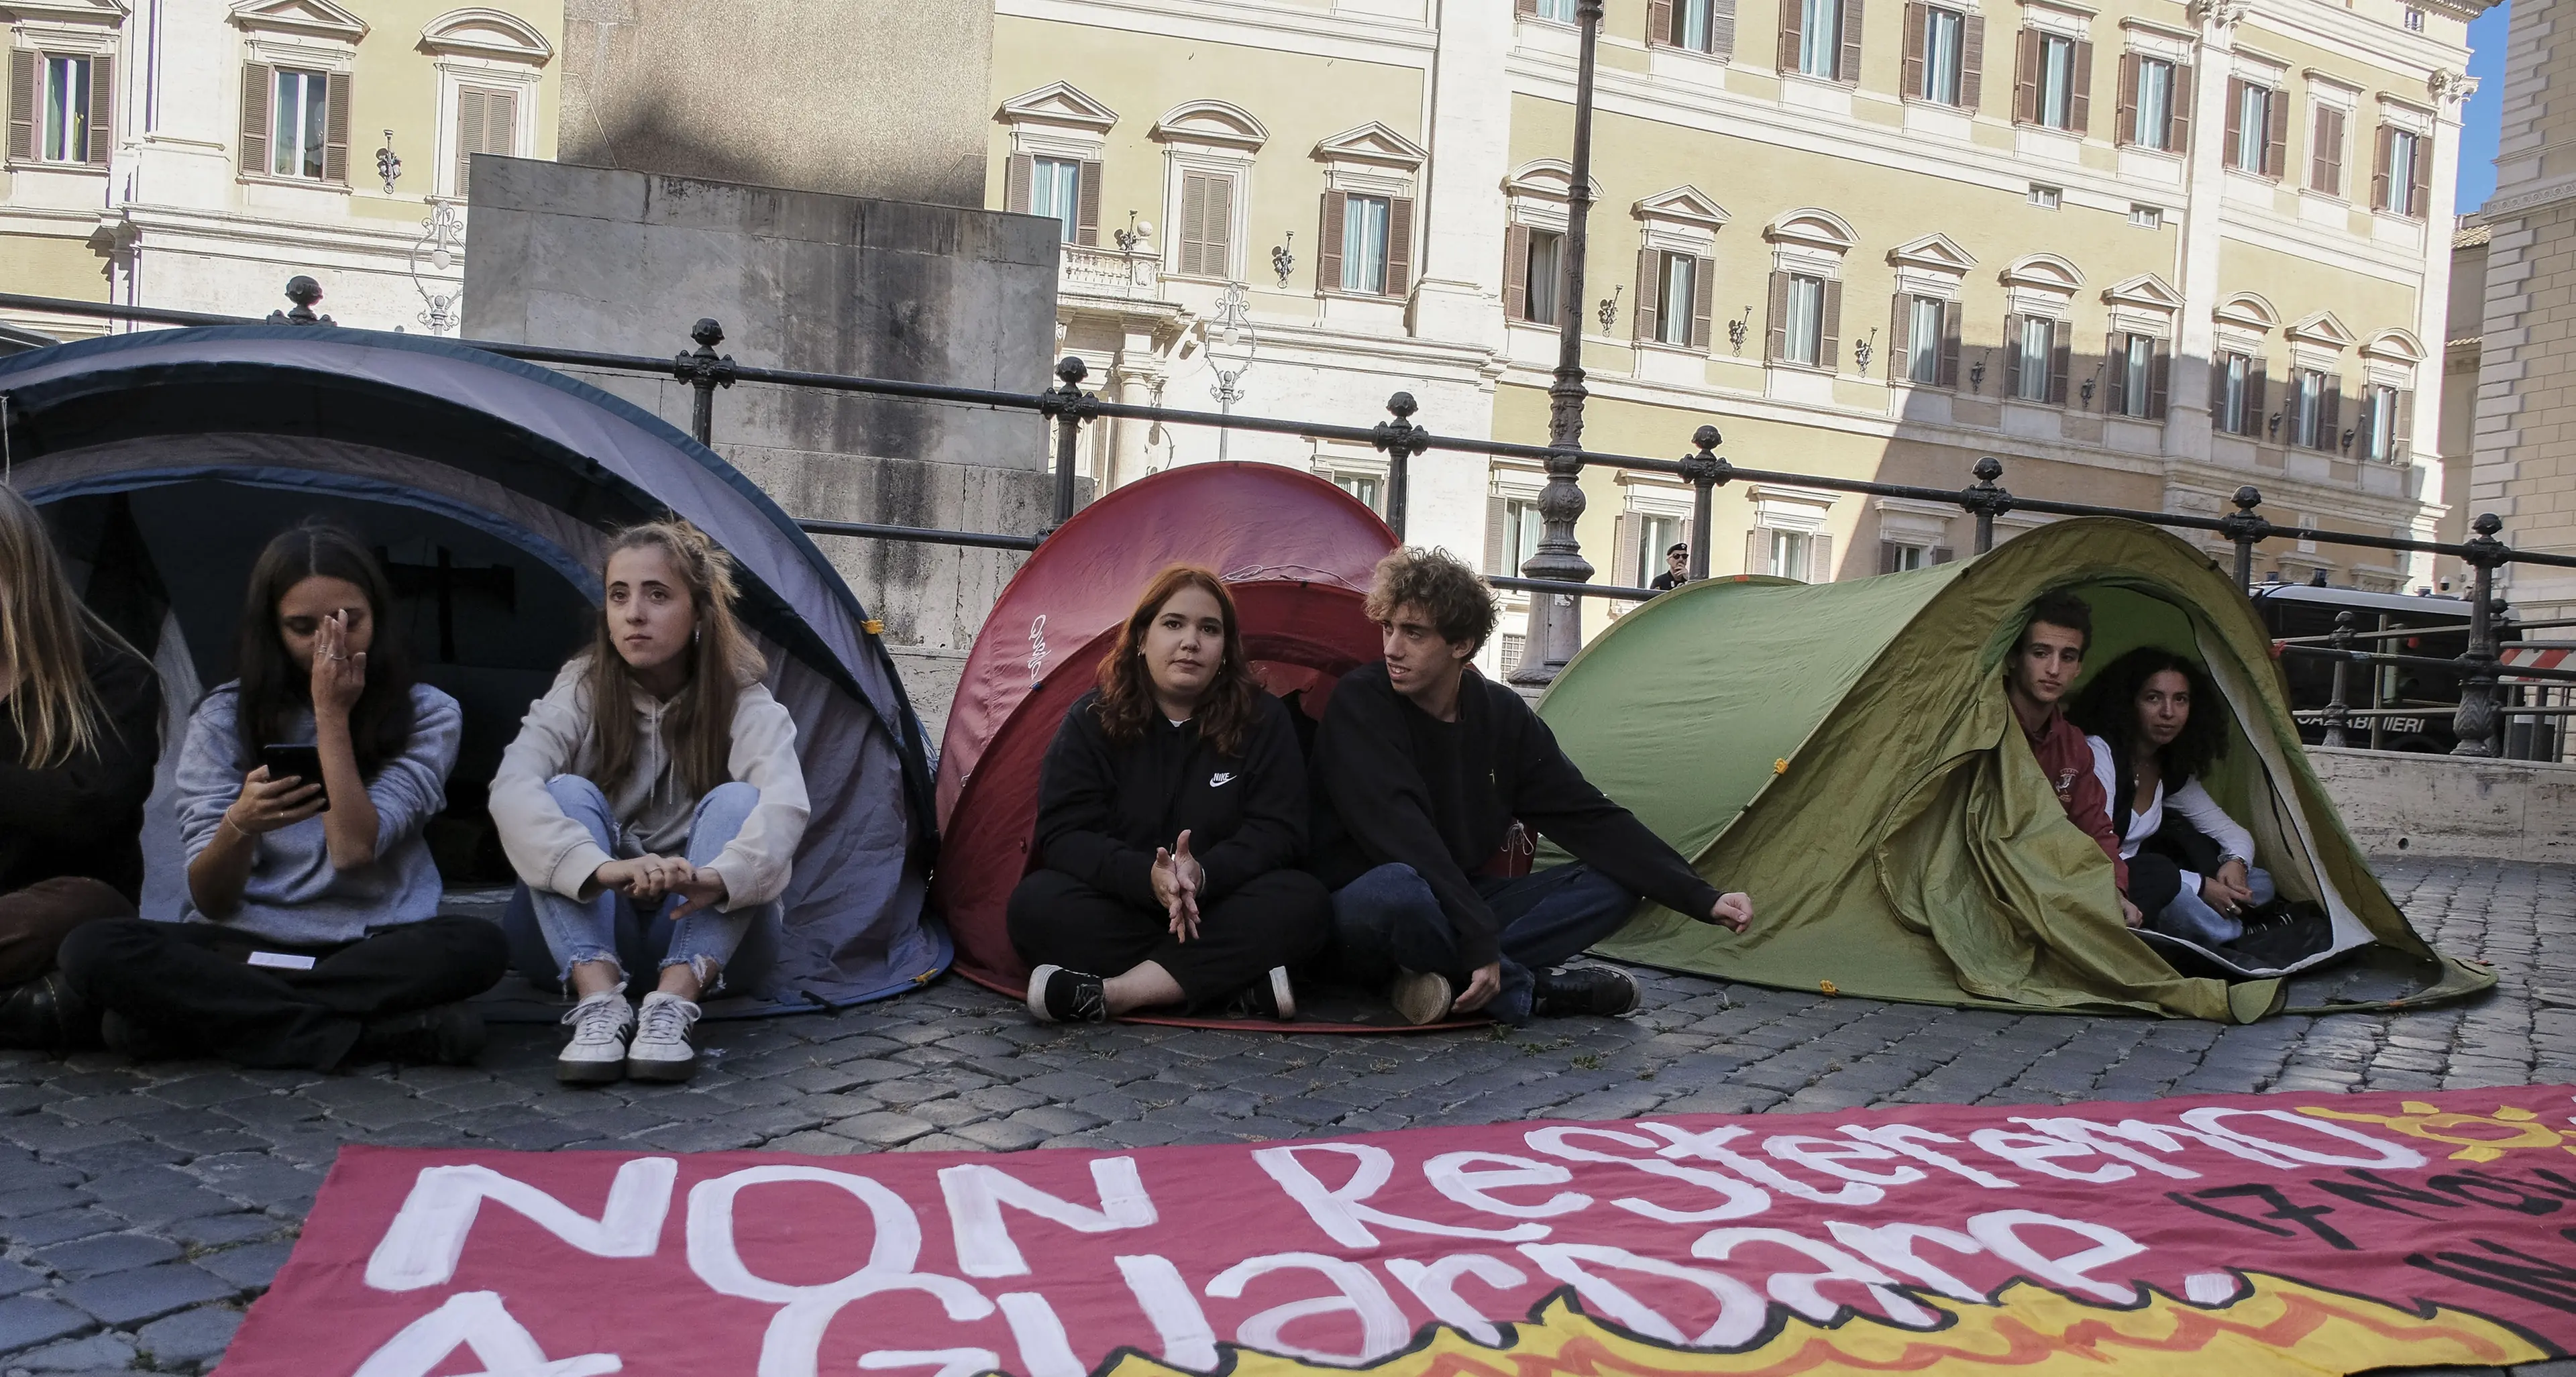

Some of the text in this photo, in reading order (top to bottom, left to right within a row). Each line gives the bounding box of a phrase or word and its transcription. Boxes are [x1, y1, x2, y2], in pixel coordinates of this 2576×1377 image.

[2297, 715, 2424, 733] ABIIERI
[1213, 773, 1230, 781] NIKE
[364, 1156, 1158, 1304] NON
[2165, 1182, 2359, 1250] 17
